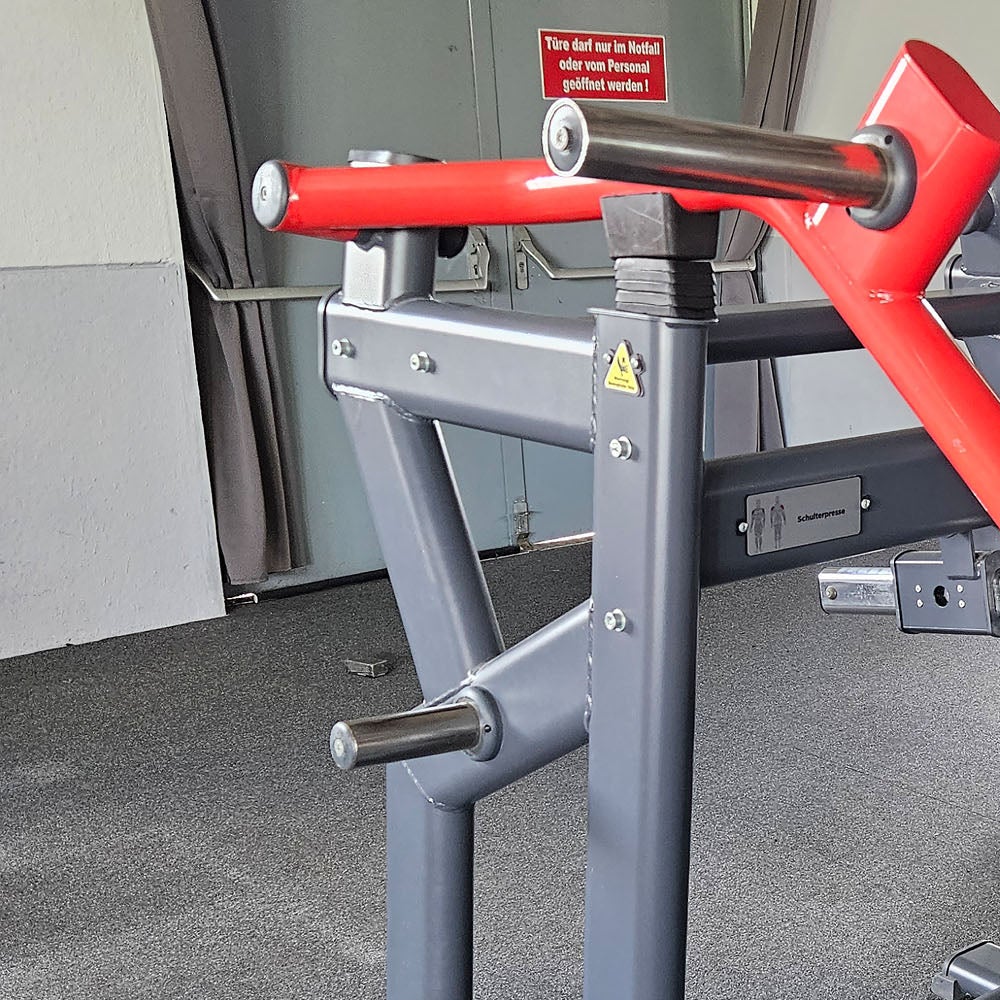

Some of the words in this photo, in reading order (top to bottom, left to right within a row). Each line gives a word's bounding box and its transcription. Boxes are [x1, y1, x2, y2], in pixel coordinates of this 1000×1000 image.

[544, 36, 569, 51] Türe
[572, 38, 592, 52] darf
[595, 40, 612, 53] nur
[614, 40, 626, 54] im
[628, 41, 660, 55] Notfall
[559, 57, 582, 71] oder
[585, 60, 606, 72] vom
[608, 59, 650, 74] Personal
[563, 77, 605, 93] geöffnet
[607, 79, 643, 92] werden
[797, 508, 846, 523] Schulterpresse
